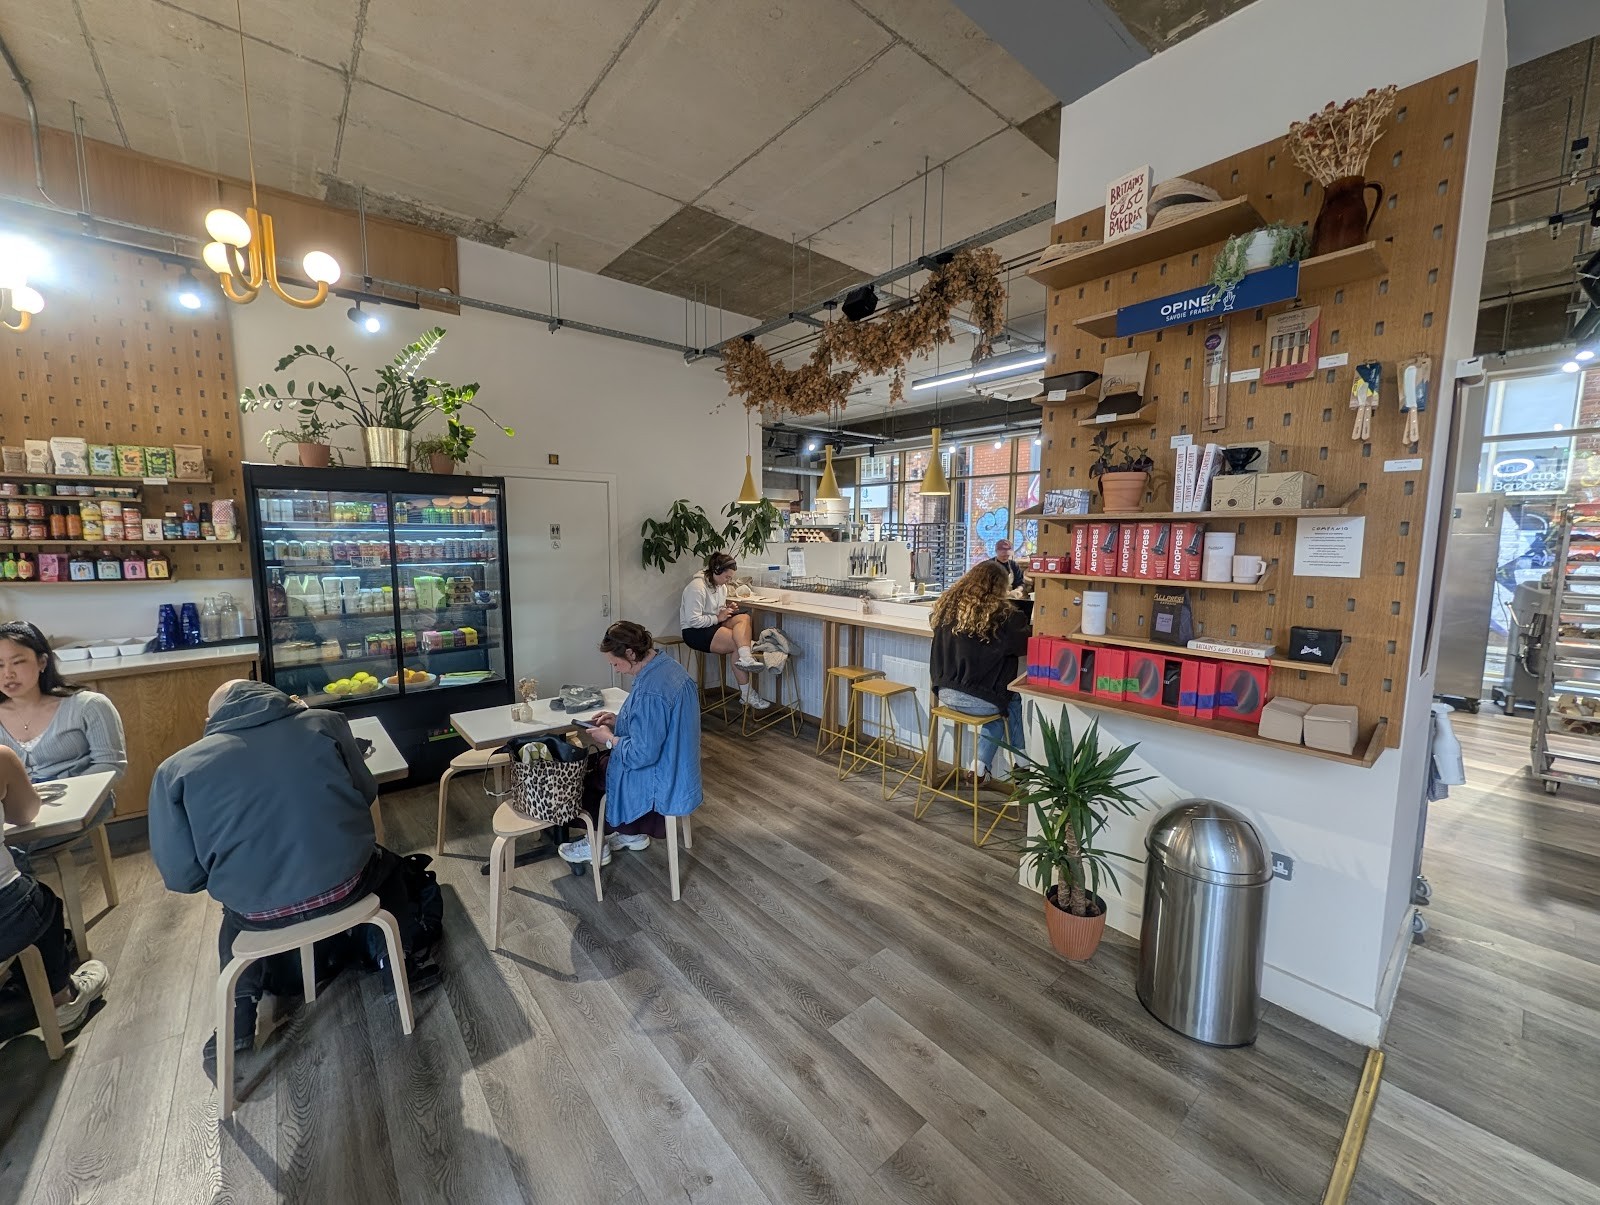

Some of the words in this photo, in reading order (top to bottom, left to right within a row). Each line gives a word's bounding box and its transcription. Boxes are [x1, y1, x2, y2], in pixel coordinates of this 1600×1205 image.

[1160, 293, 1222, 316] OPINEL
[1165, 312, 1187, 322] SAVOIE
[1189, 306, 1215, 317] FRANCE
[1074, 529, 1083, 571] AeroPress
[1090, 529, 1099, 572] AeroPress
[1121, 529, 1131, 573] AeroPress
[1139, 529, 1150, 575] AeroPress
[1172, 529, 1184, 576] AeroPress
